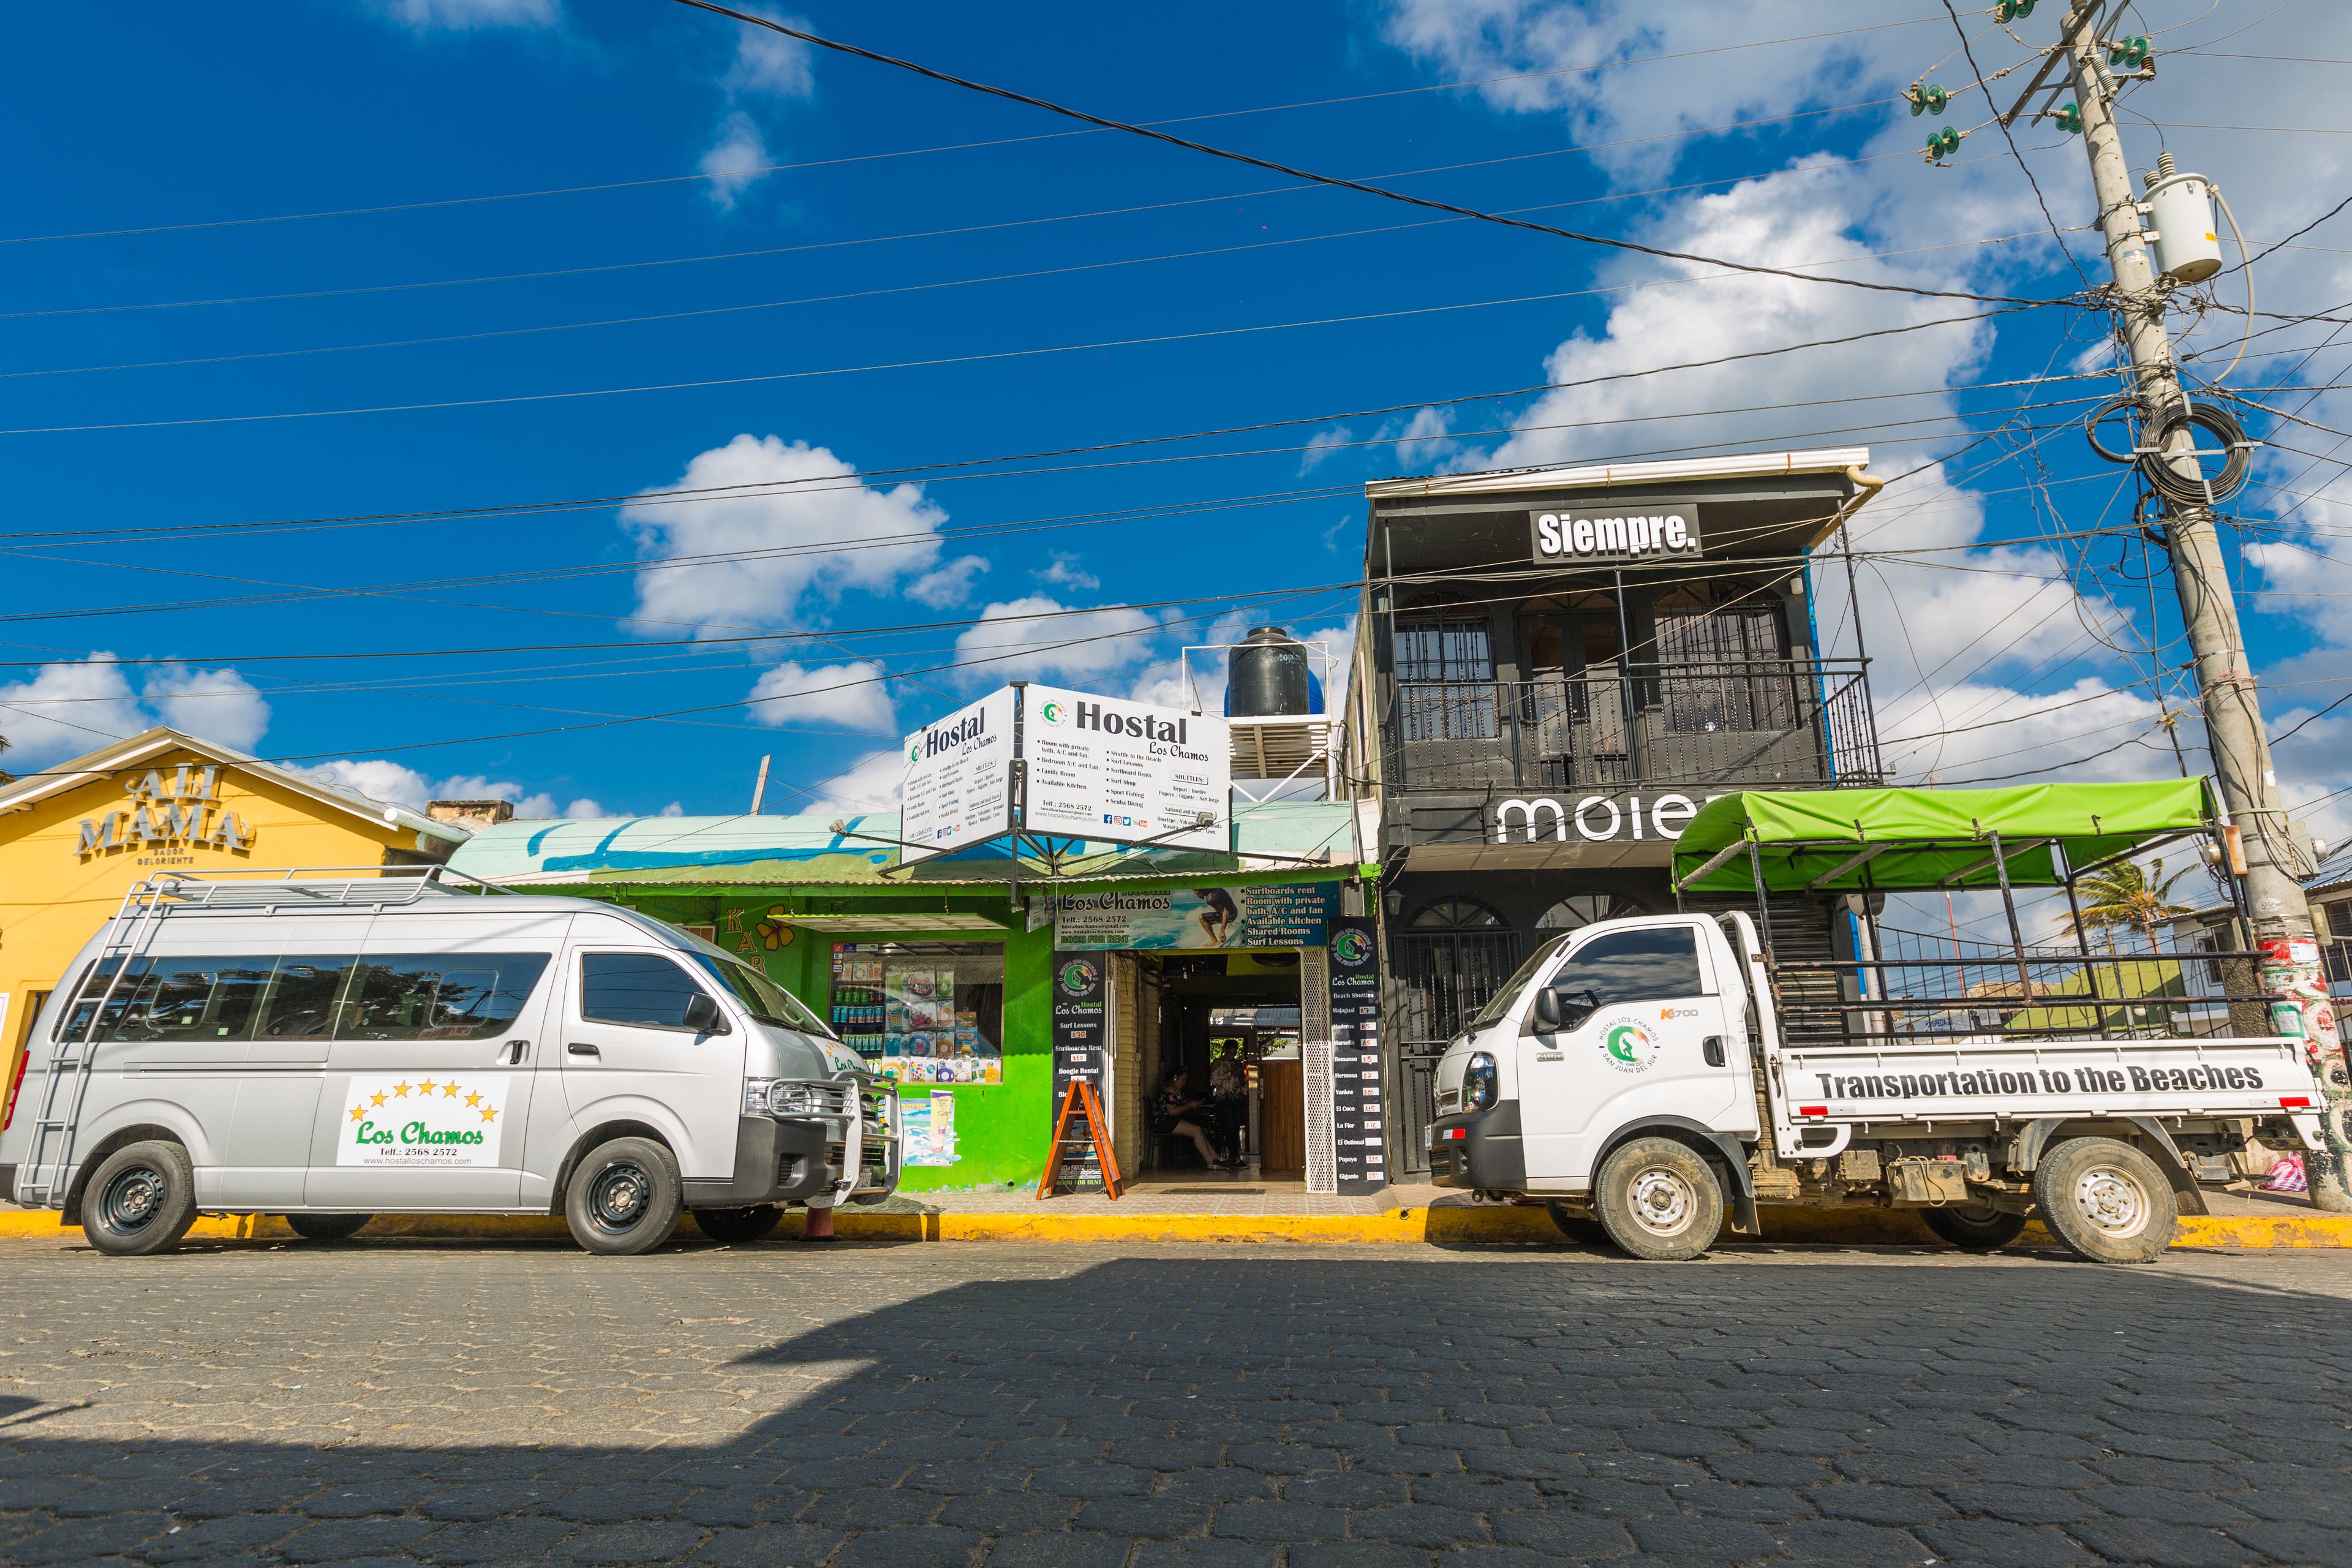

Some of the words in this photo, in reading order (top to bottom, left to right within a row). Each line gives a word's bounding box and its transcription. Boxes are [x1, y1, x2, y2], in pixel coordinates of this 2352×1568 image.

[1538, 514, 1696, 554] Siempre.
[1077, 701, 1186, 745] Hostal
[926, 706, 985, 759] Hostal
[962, 742, 973, 756] Los
[973, 733, 997, 750] Chamos
[1149, 742, 1167, 756] Los
[1170, 745, 1209, 762] Chamos
[1041, 757, 1065, 766] Bedroom
[1110, 767, 1137, 776] Surfboard
[1175, 774, 1204, 783] SHUTTLES:
[1035, 811, 1098, 823] www.hostalloschamos.com
[72, 804, 250, 856] MAMA
[1061, 894, 1094, 911] Los
[1099, 892, 1170, 911] Chamos
[1295, 896, 1325, 906] private
[1246, 907, 1269, 916] bath,
[1271, 907, 1287, 916] A/C
[1247, 927, 1280, 936] Shared
[1281, 927, 1311, 935] Rooms
[1061, 935, 1086, 944] ROOM
[1107, 935, 1129, 943] RENT
[1332, 977, 1345, 986] Los
[1346, 977, 1374, 986] Chamos
[1055, 1005, 1069, 1015] Los
[1071, 1005, 1102, 1014] Chamos
[1660, 1008, 1698, 1020] K2700
[1599, 1020, 1616, 1040] HOSTAL
[1633, 1019, 1659, 1042] CHAMOS
[1602, 1053, 1615, 1066] SAN
[1647, 1054, 1657, 1066] SUR
[1815, 1069, 2038, 1099] Transportation
[2039, 1069, 2071, 1093] to
[2075, 1067, 2127, 1093] the
[2127, 1065, 2263, 1093] Beaches
[356, 1121, 394, 1145] Los
[401, 1121, 483, 1145] Chamos
